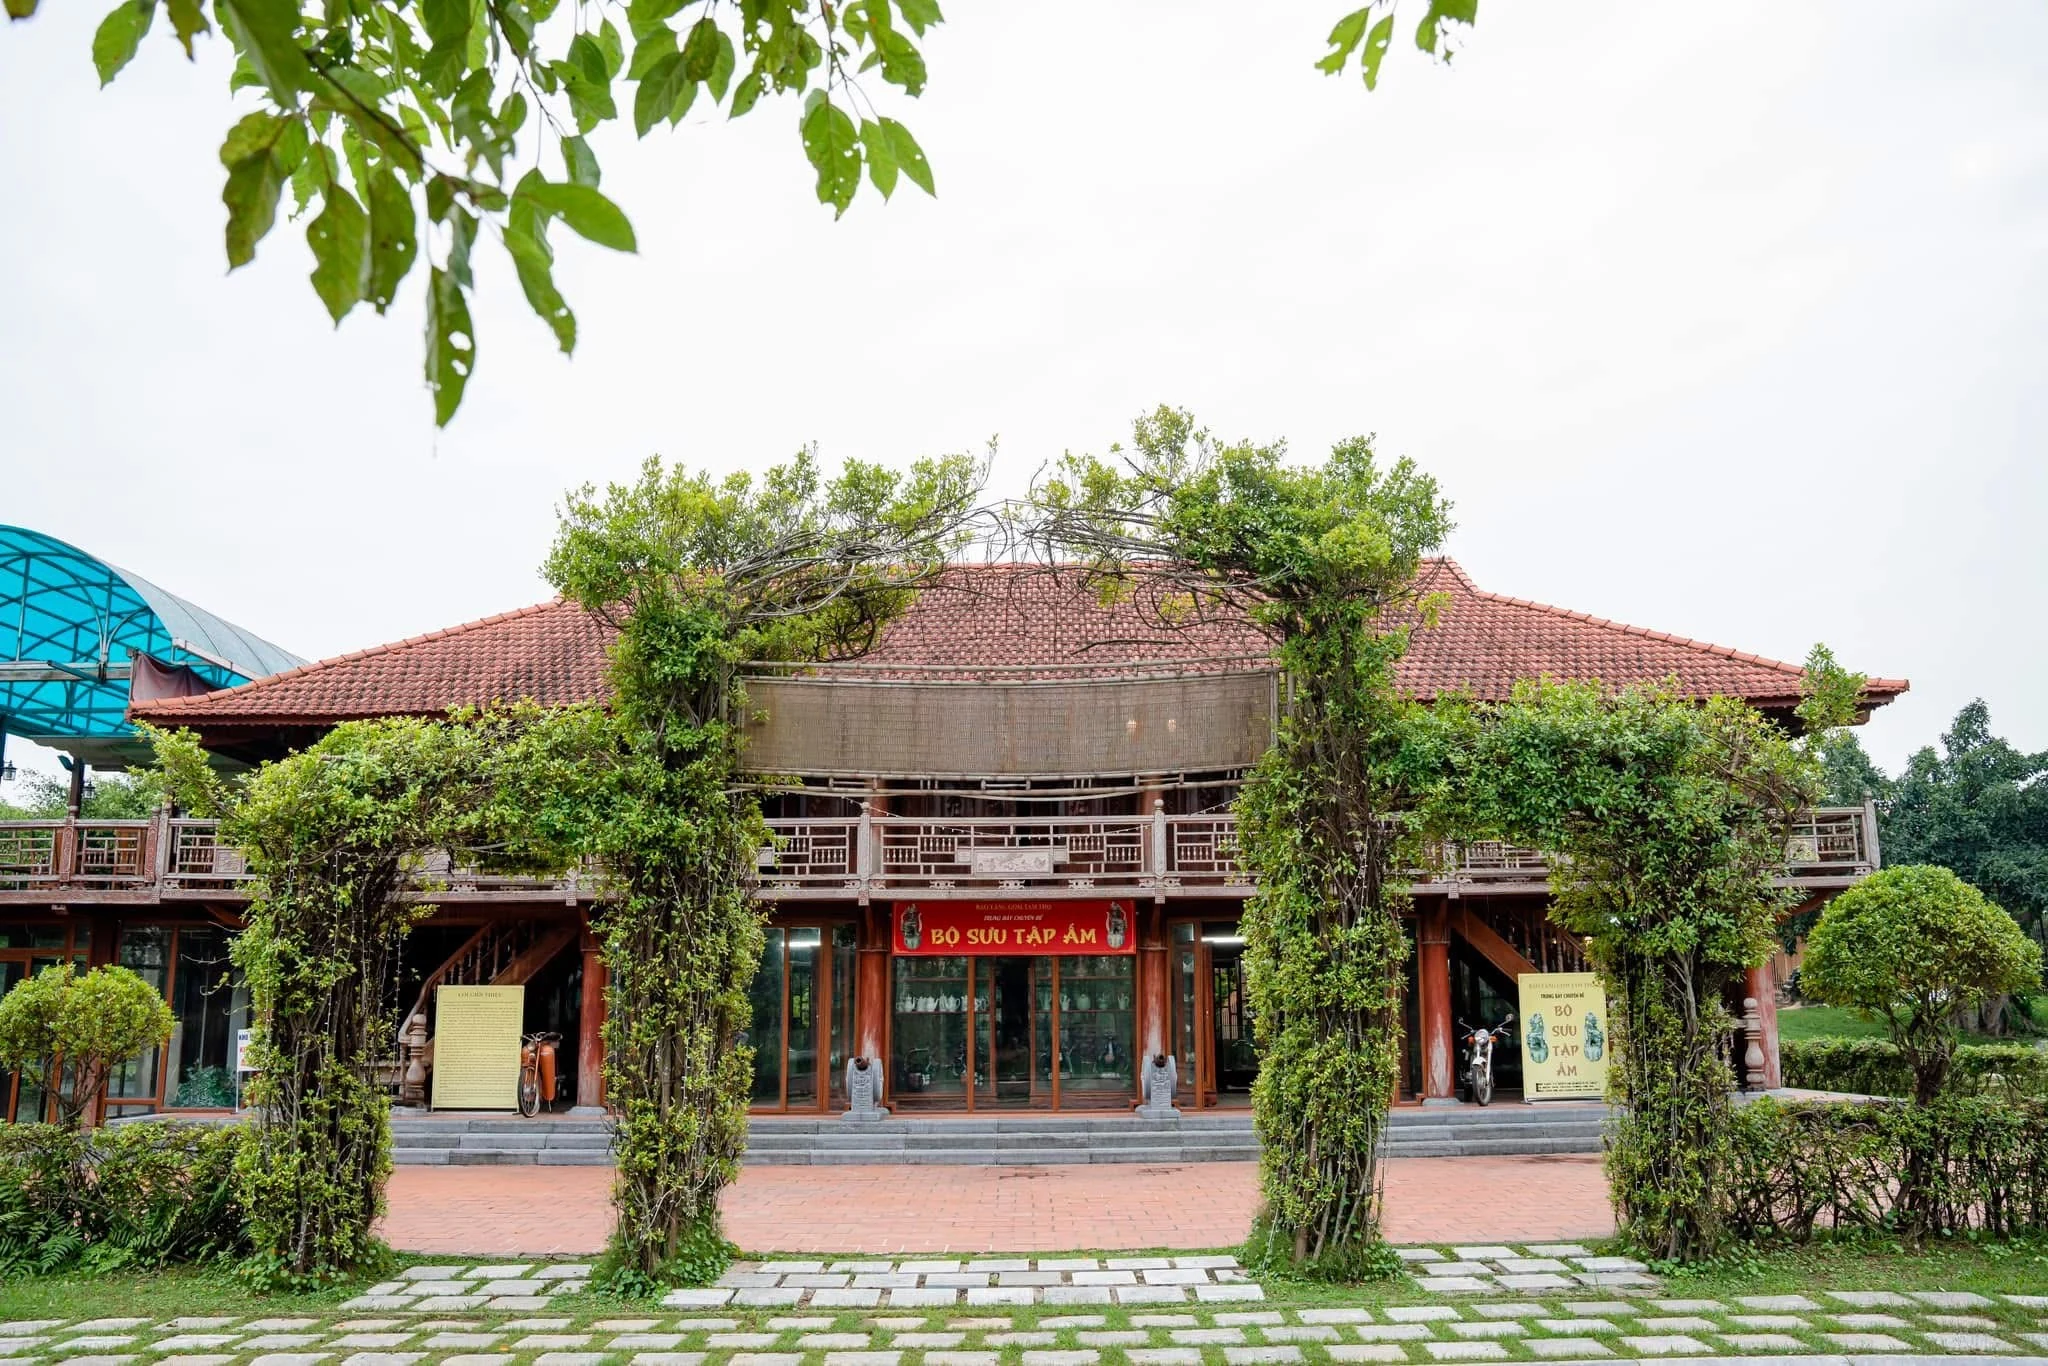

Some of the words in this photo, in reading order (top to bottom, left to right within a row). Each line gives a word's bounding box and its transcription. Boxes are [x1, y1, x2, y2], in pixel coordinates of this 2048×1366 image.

[931, 926, 960, 948] BỘ
[967, 927, 1007, 945] SƯU
[1013, 926, 1056, 948] TẬP
[1063, 923, 1096, 945] ẤM
[1552, 1024, 1577, 1037] SƯU
[1552, 1042, 1579, 1058] TẬP
